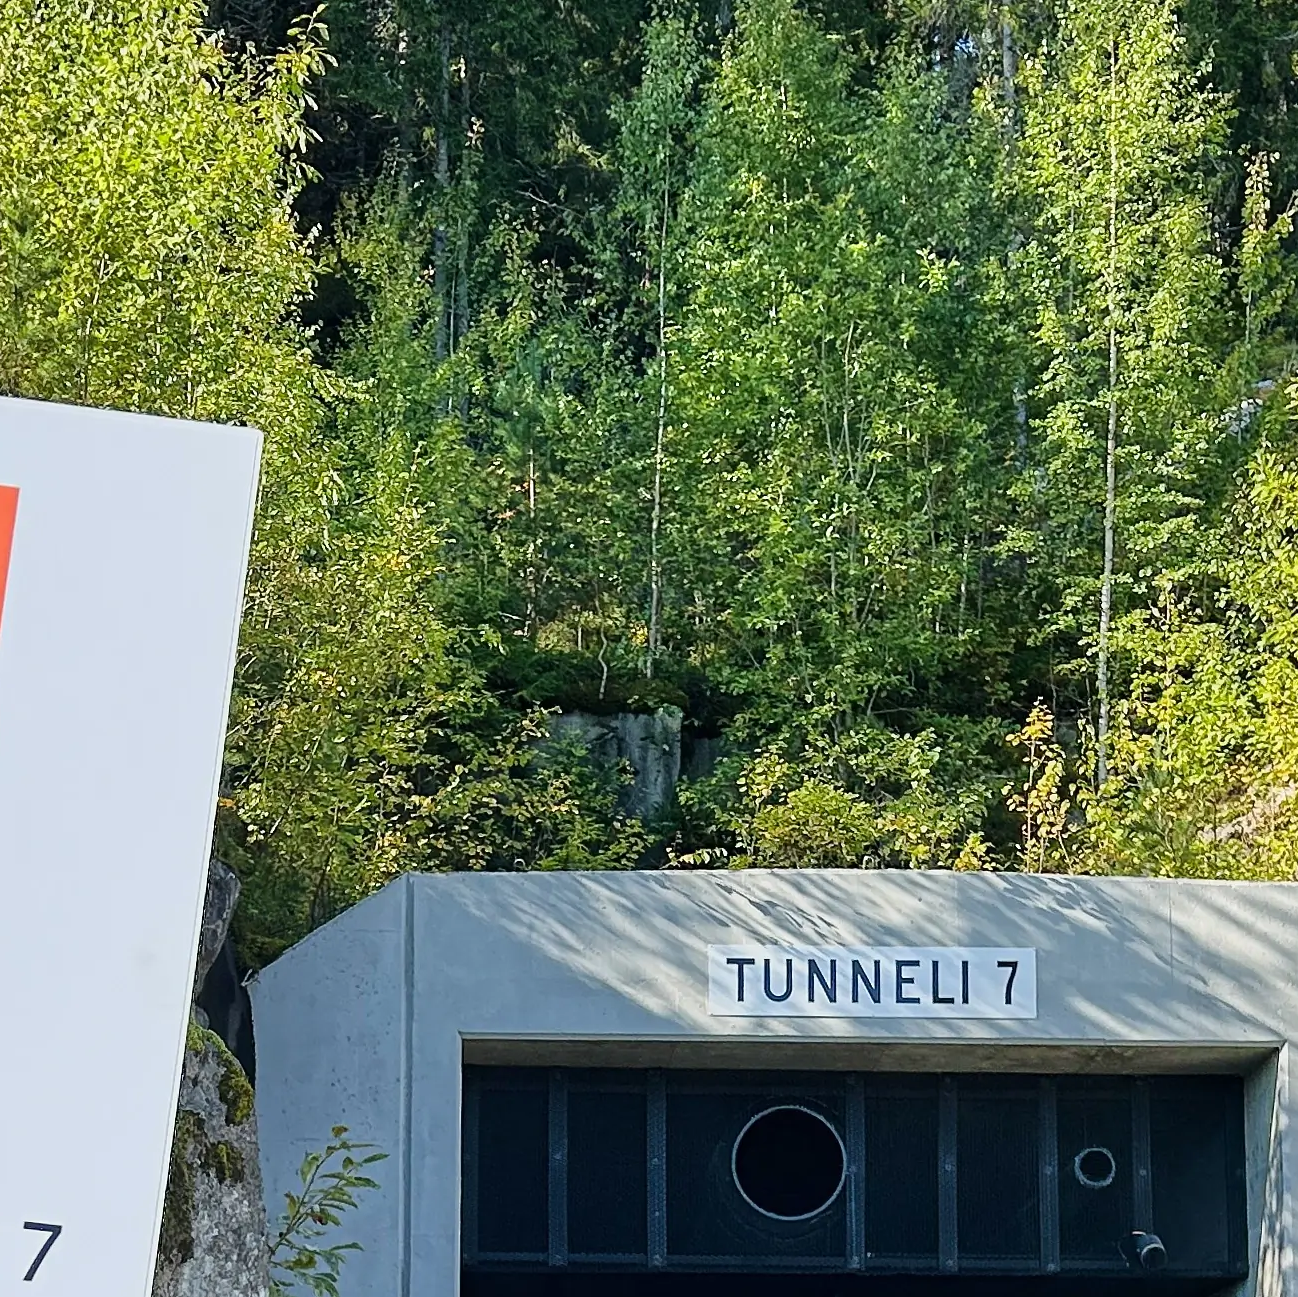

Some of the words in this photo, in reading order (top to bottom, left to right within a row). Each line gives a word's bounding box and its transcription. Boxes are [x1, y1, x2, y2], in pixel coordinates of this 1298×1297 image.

[725, 956, 970, 1006] TUNNELI
[995, 959, 1020, 1006] 7
[22, 1220, 64, 1283] 7
